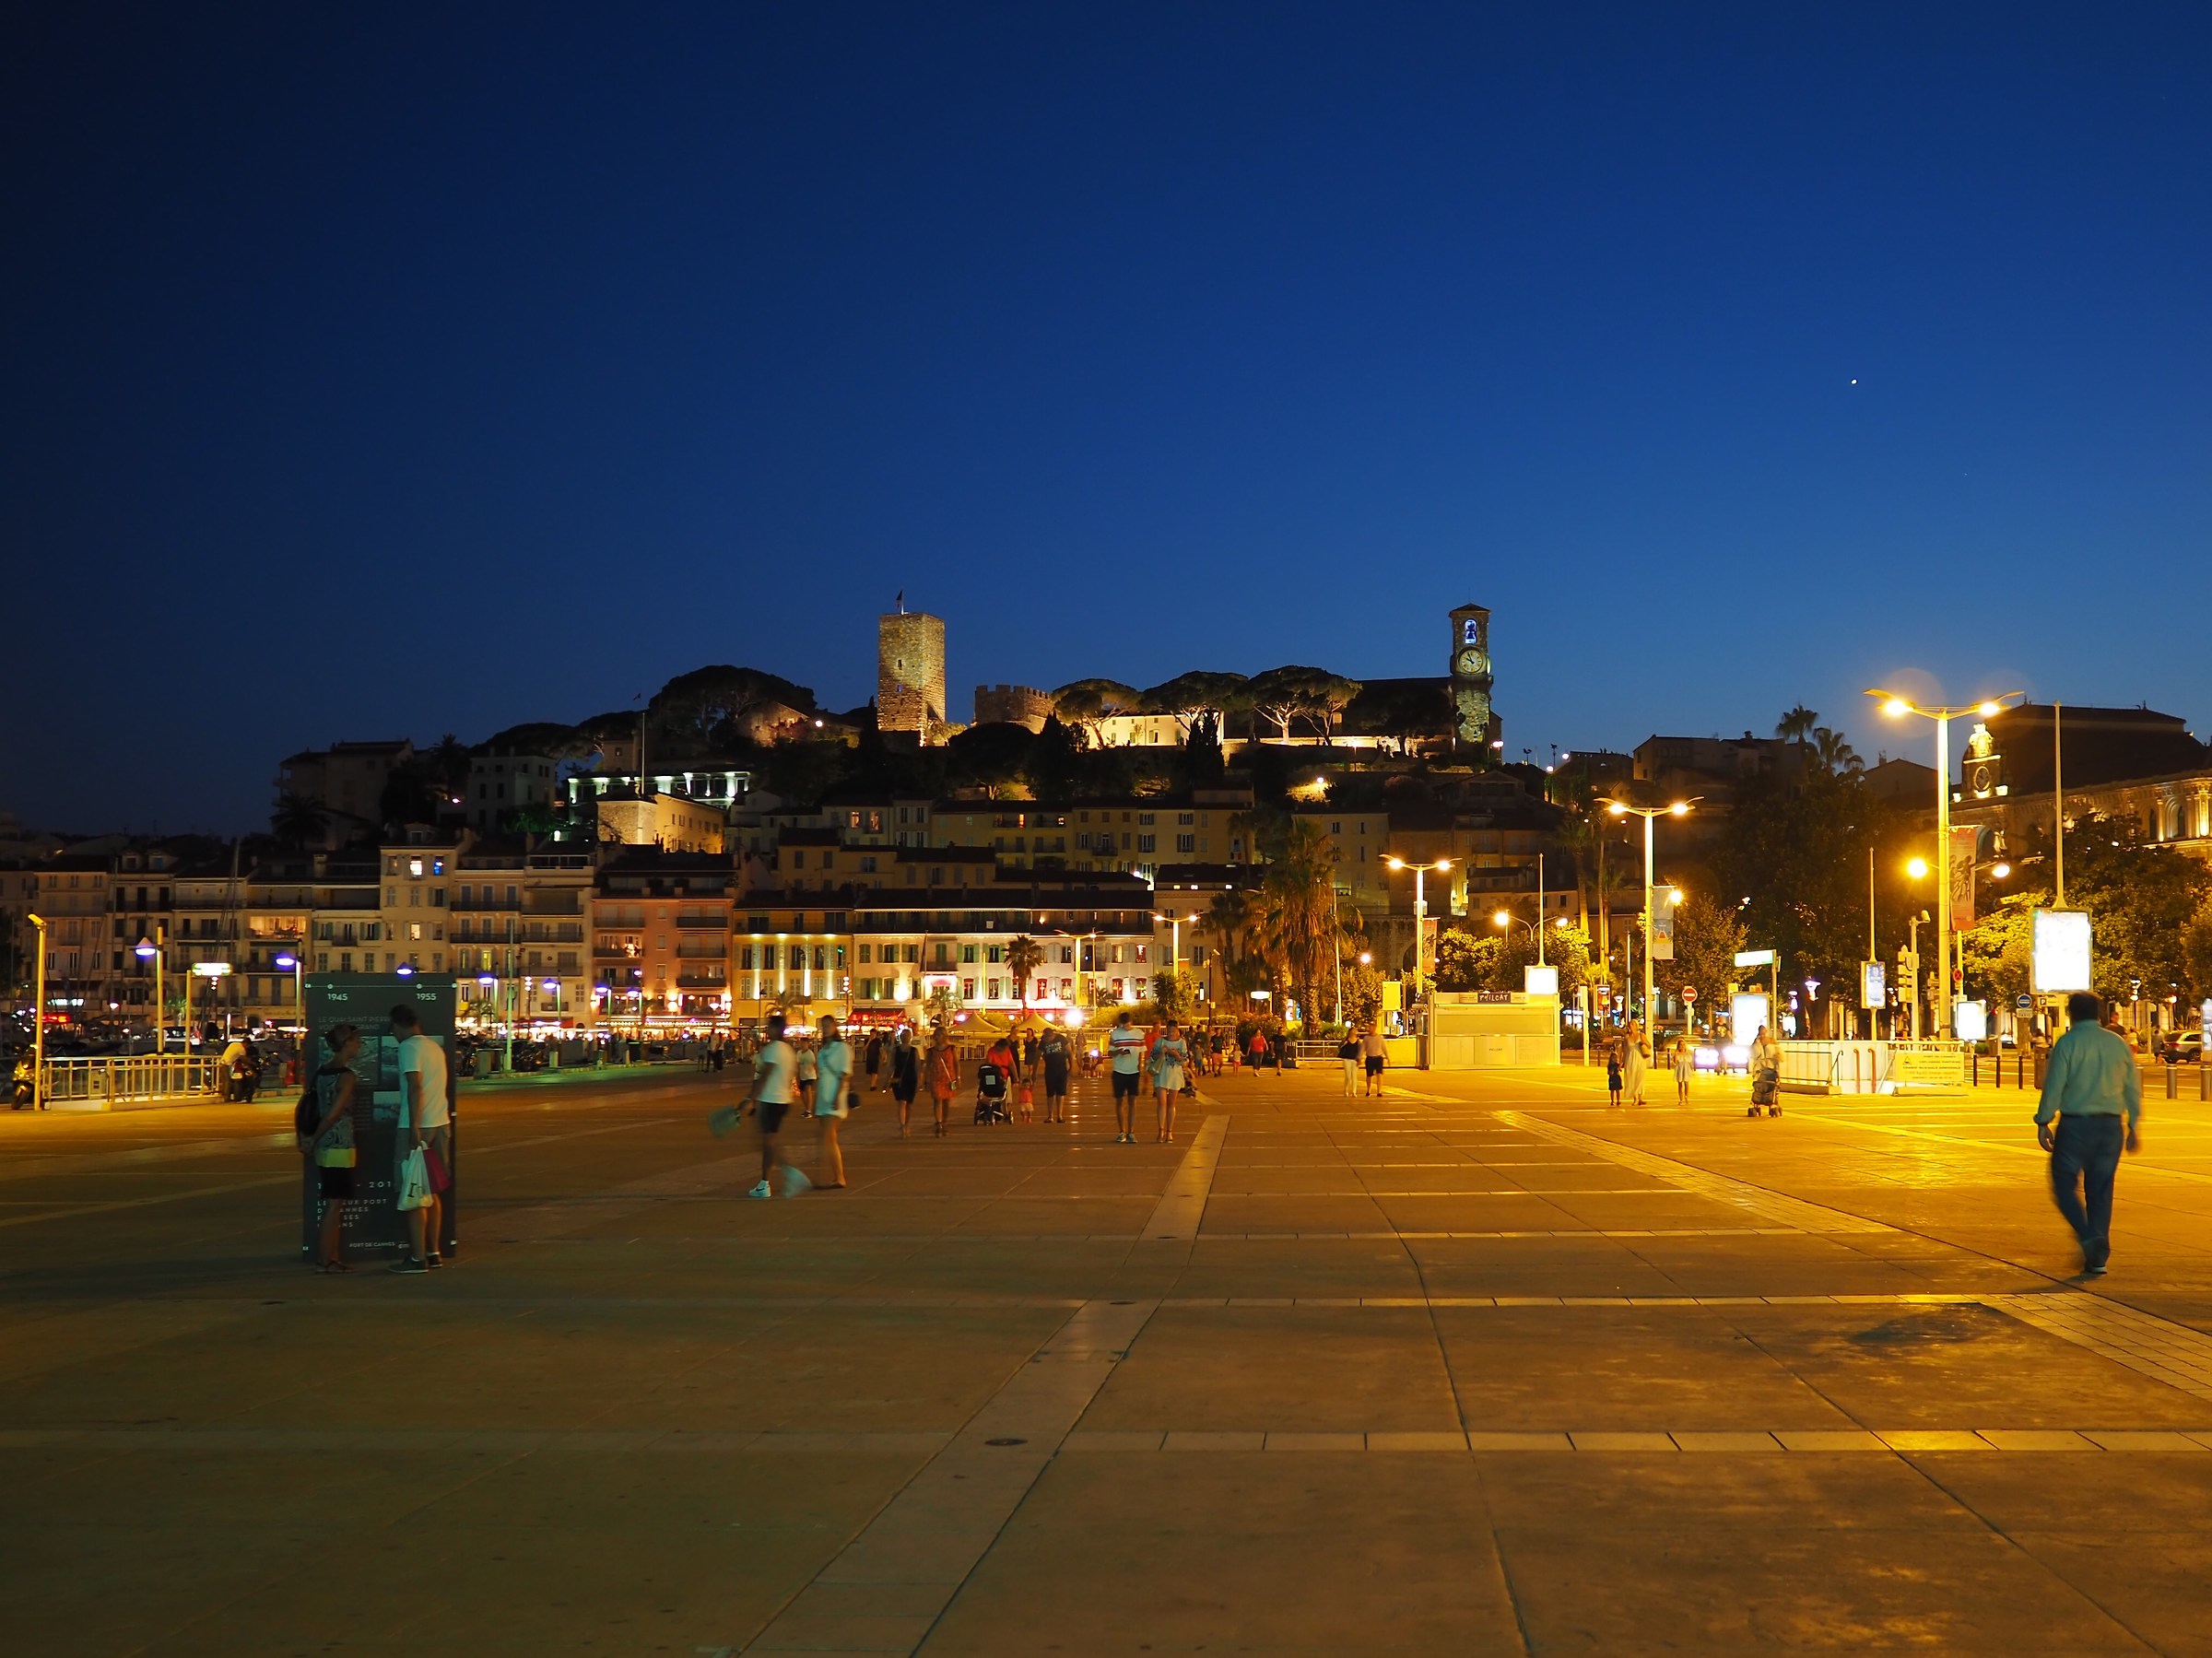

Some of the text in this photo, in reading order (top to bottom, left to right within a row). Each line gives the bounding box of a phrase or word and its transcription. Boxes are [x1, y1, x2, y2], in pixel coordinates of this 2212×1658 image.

[327, 993, 348, 1001] 1945
[416, 993, 437, 1001] 1955
[1479, 994, 1509, 1002] PHILCAT
[369, 1181, 392, 1189] 201
